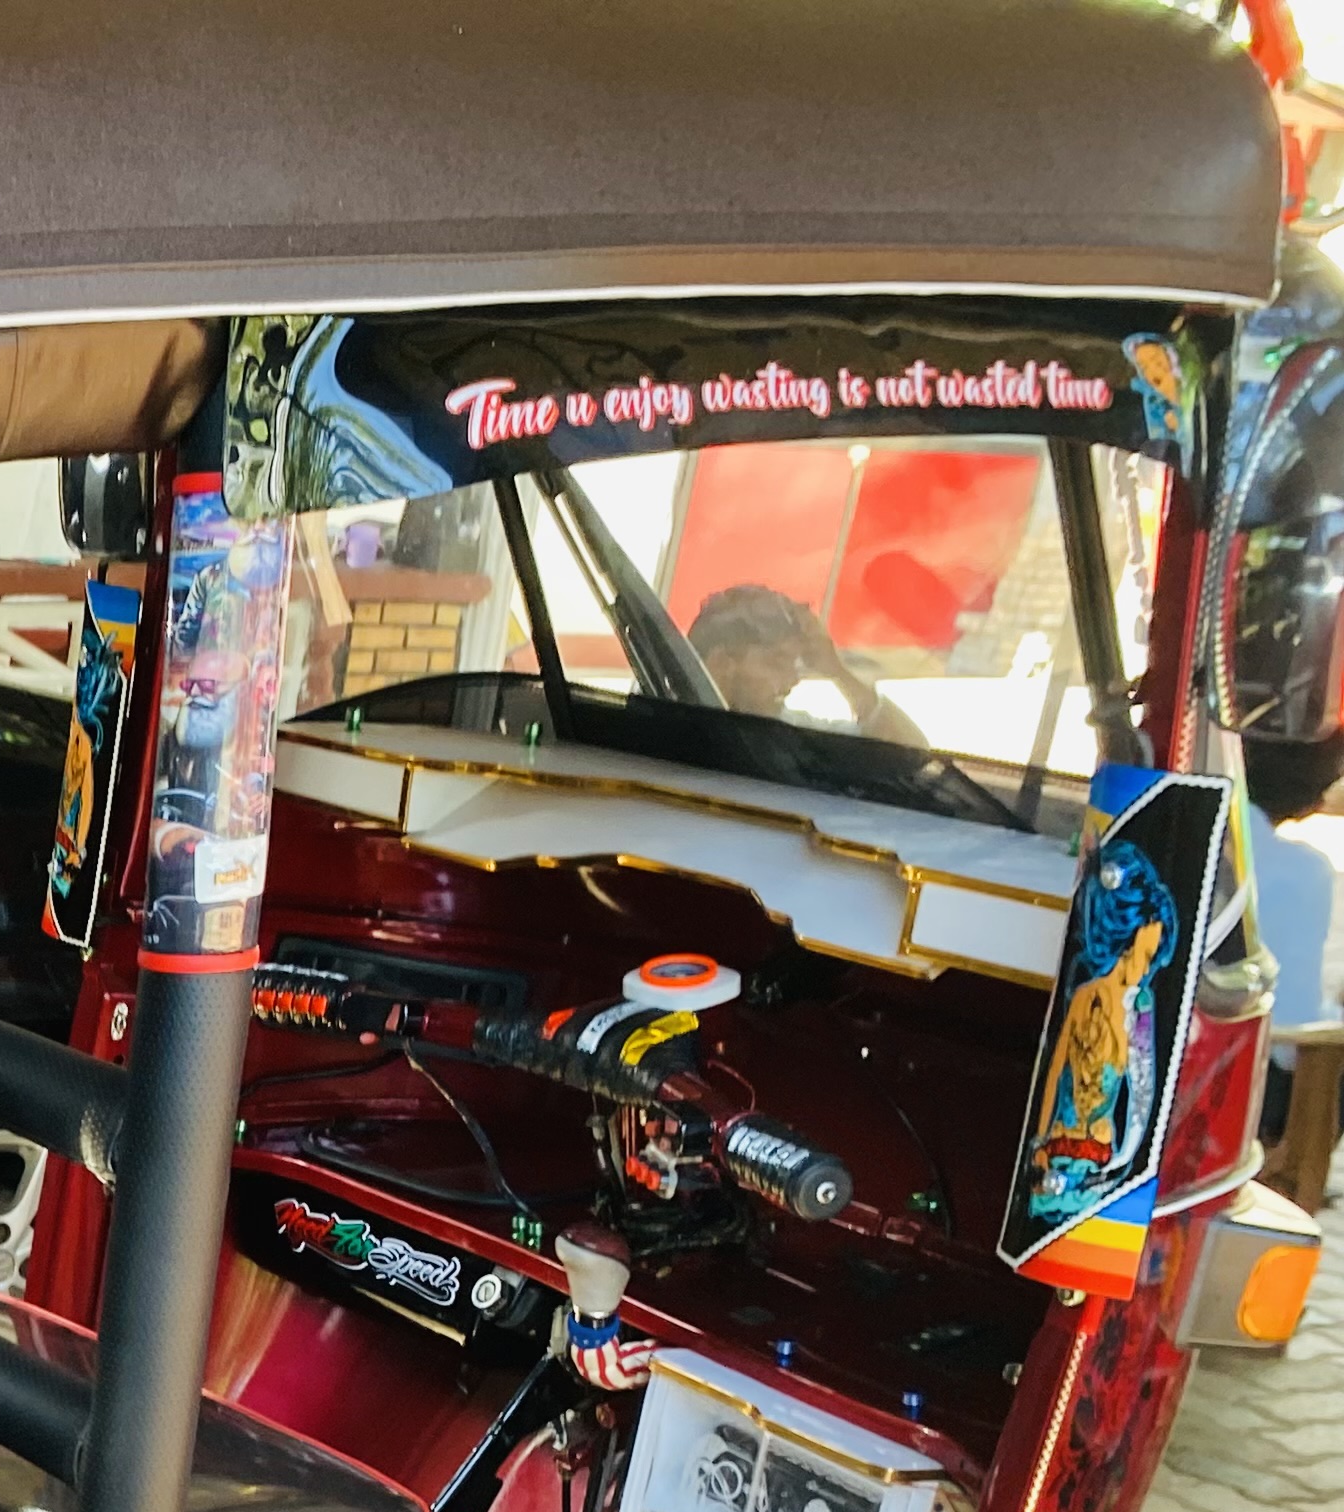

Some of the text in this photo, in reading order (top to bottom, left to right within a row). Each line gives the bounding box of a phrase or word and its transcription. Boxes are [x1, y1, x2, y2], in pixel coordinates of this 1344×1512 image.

[445, 377, 559, 450] Time
[603, 375, 694, 432] enjoy
[701, 360, 831, 419] wasting
[838, 367, 872, 409] is
[875, 359, 939, 409] not
[934, 360, 1043, 409] wasted
[1040, 360, 1114, 412] time
